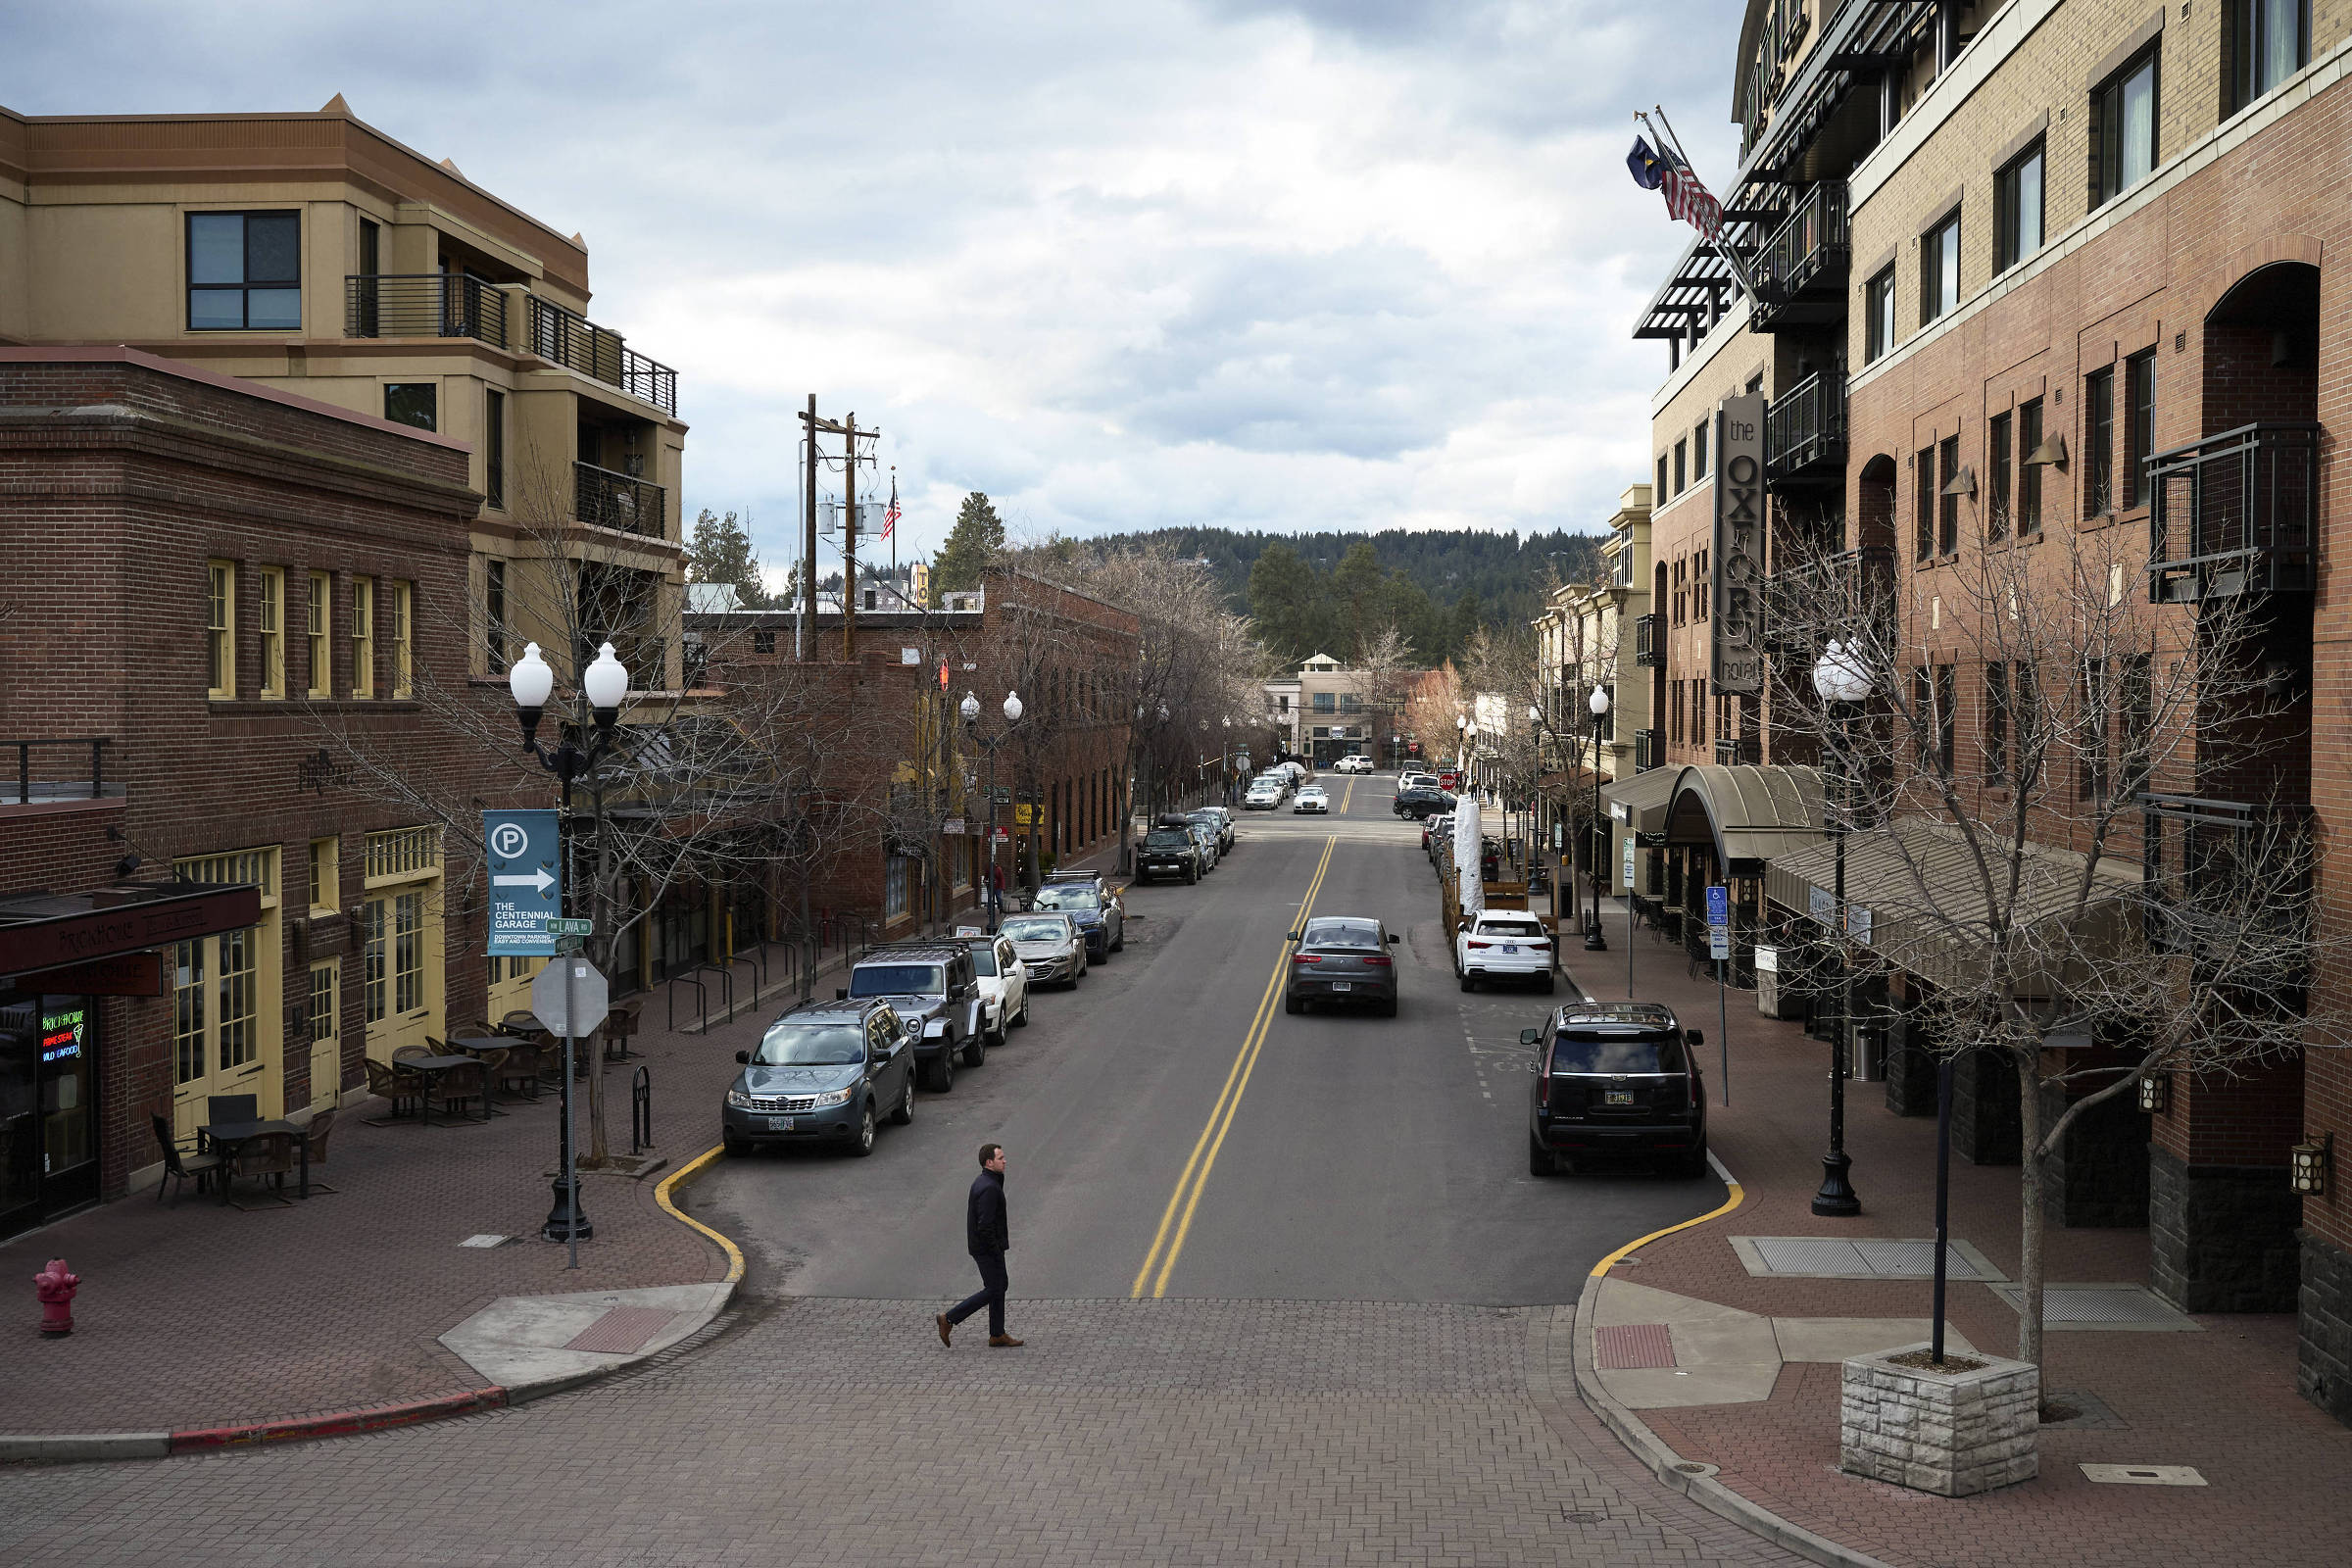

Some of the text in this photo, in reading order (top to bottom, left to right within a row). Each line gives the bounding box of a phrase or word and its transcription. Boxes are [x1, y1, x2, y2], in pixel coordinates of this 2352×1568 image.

[1731, 420, 1754, 441] the
[1728, 455, 1758, 651] OXFORD
[1722, 660, 1755, 680] hotel
[503, 831, 519, 851] P
[495, 902, 515, 910] THE
[495, 920, 537, 929] GARAGE
[560, 921, 579, 933] LAVA
[58, 1032, 73, 1043] STEAK
